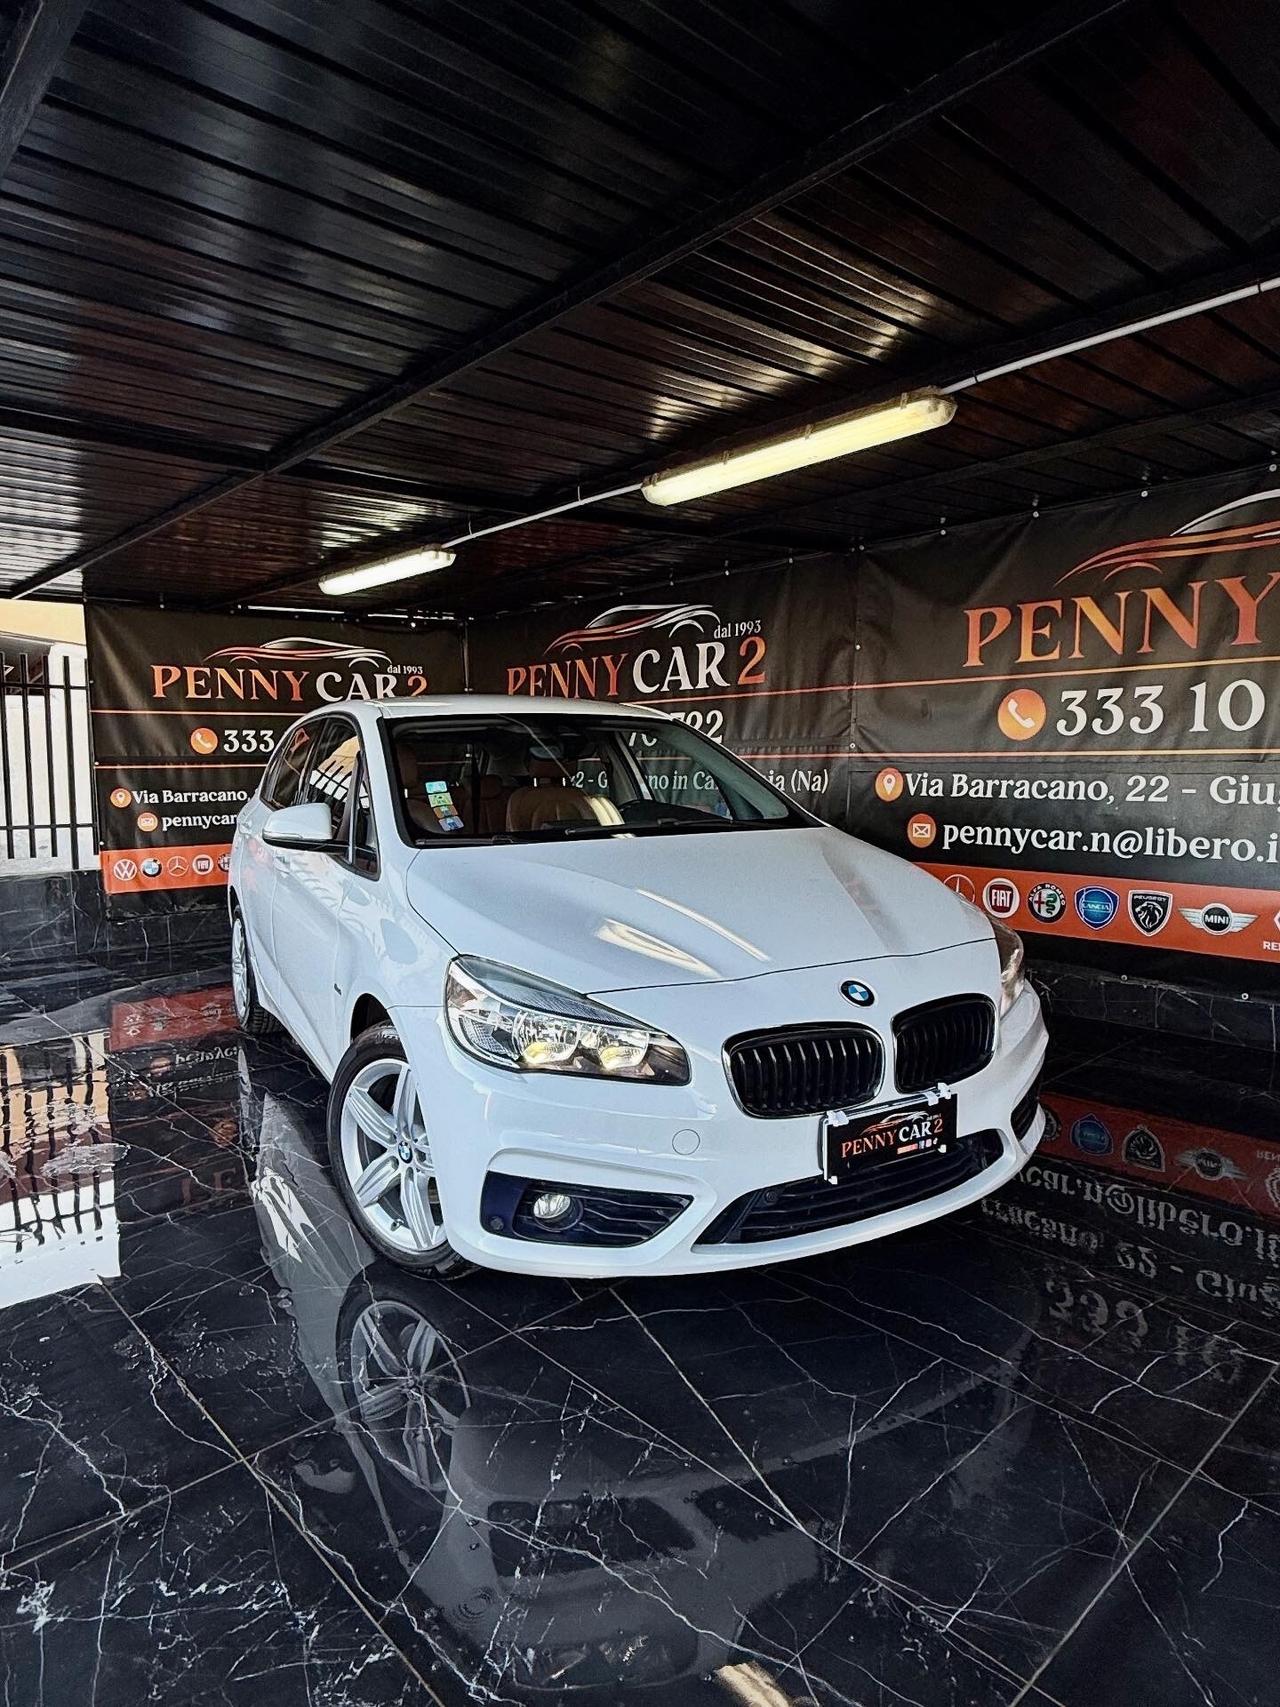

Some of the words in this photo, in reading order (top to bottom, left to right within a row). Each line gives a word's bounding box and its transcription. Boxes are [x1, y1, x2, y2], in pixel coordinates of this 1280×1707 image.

[714, 624, 732, 639] dal
[734, 620, 762, 636] 1993
[962, 571, 1280, 667] PENNY
[387, 665, 400, 674] dal
[402, 666, 423, 674] 1993
[507, 653, 628, 698] PENNY
[632, 641, 730, 694] CAR
[738, 636, 767, 685] 2
[151, 664, 310, 701] PENNY
[316, 672, 397, 702] CAR
[1056, 685, 1164, 737] 333
[1189, 679, 1266, 732] 10
[223, 729, 275, 753] 333
[790, 769, 828, 794] (Na)
[905, 773, 943, 797] Via
[950, 773, 1115, 805] Barracano,
[1126, 775, 1169, 802] 22
[1209, 774, 1280, 812] Giu
[131, 790, 159, 804] Via
[991, 889, 1012, 908] FIAT
[1204, 914, 1229, 925] MINI
[841, 1130, 897, 1158] PENNY
[899, 1121, 932, 1142] CAR
[933, 1119, 943, 1133] 2
